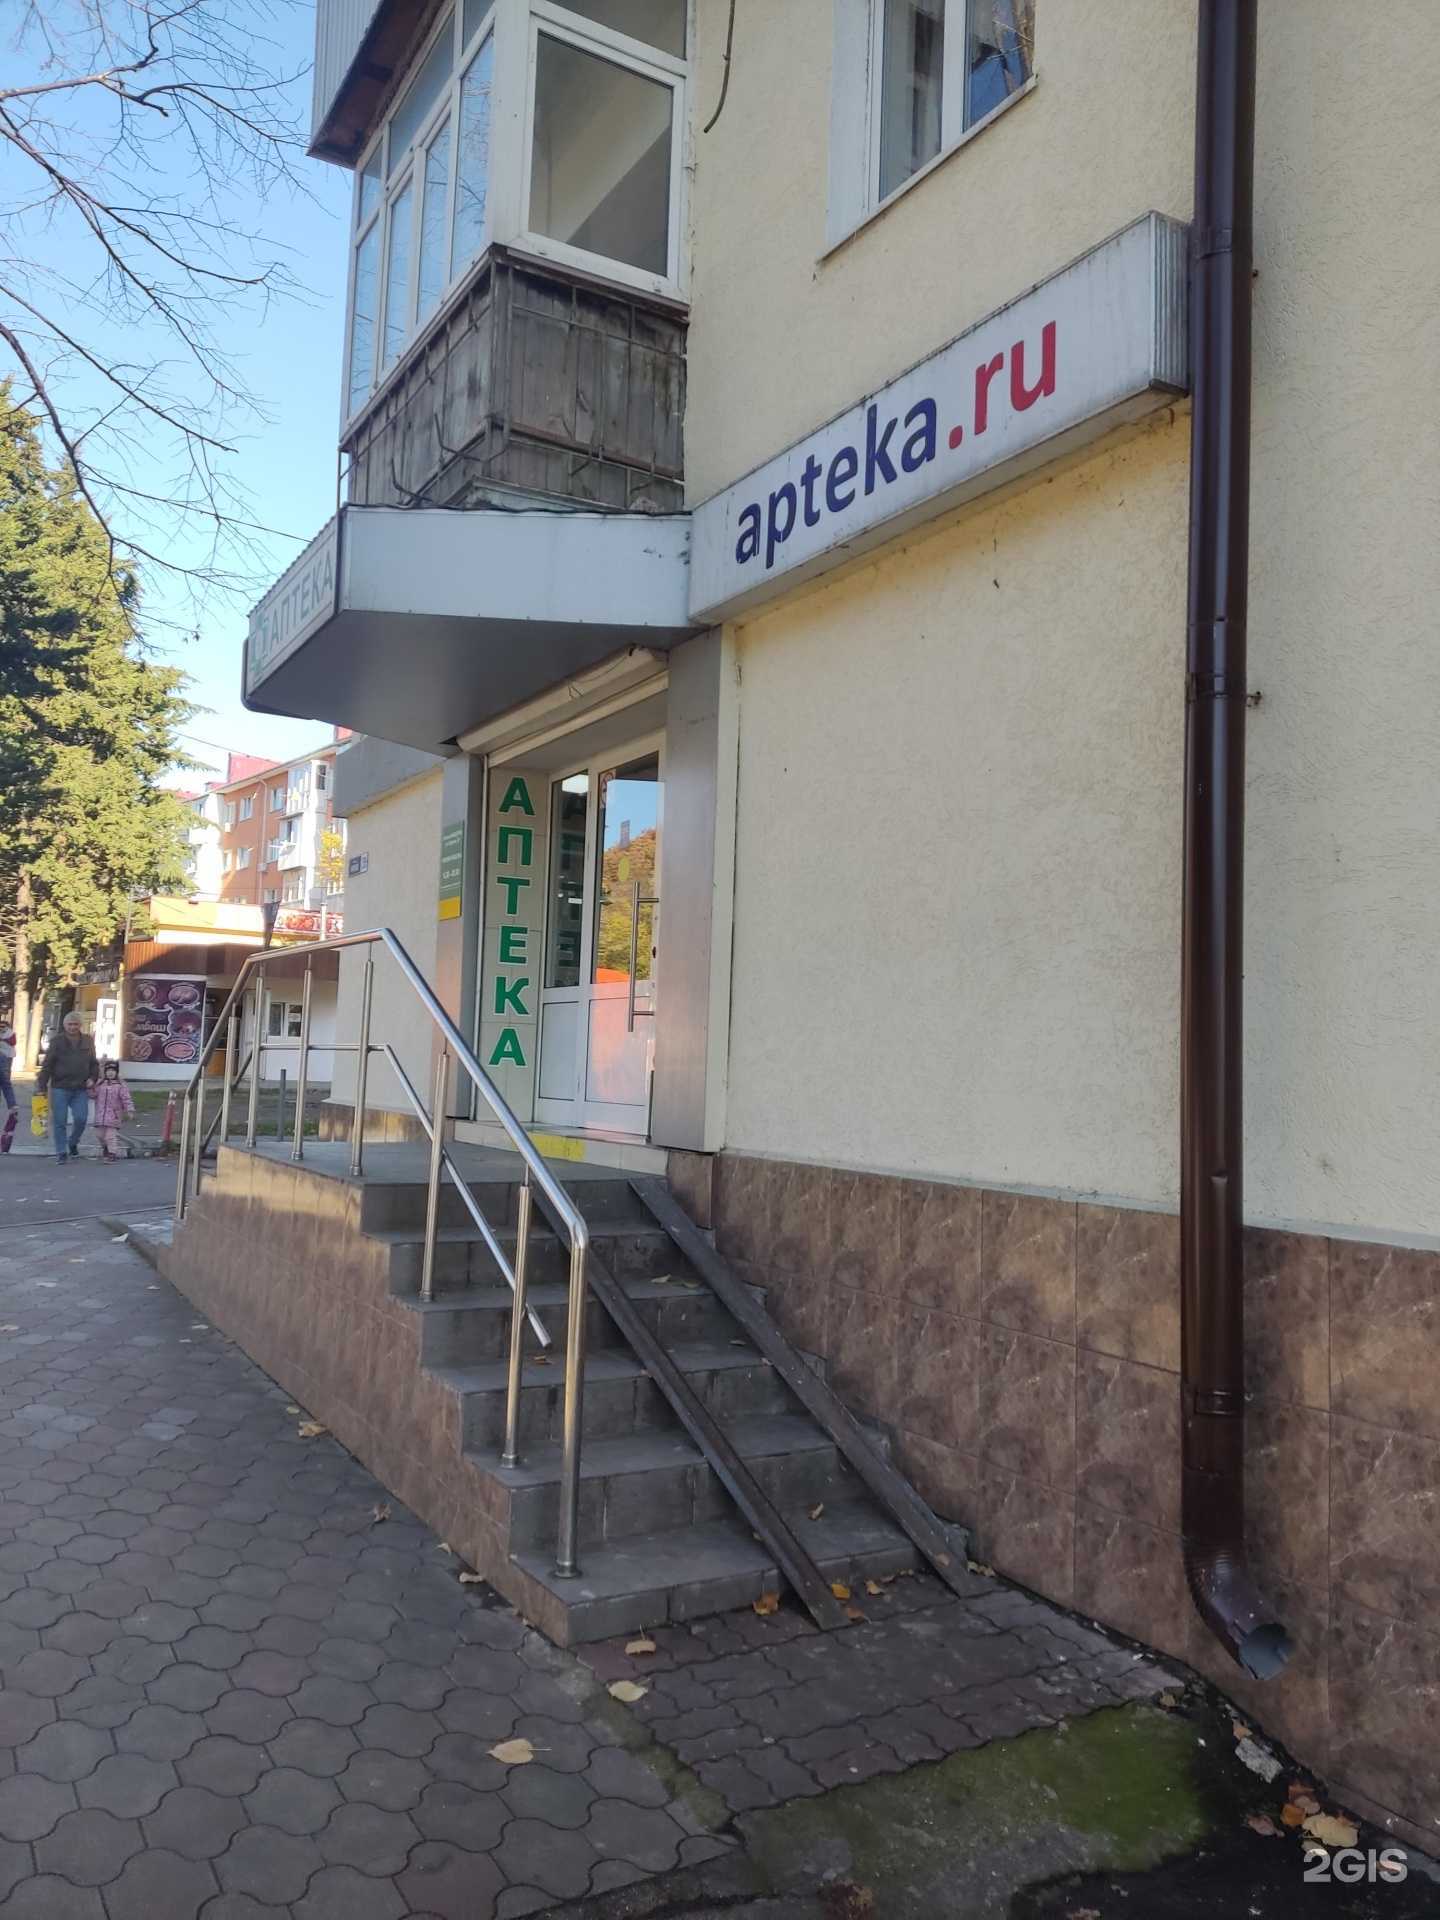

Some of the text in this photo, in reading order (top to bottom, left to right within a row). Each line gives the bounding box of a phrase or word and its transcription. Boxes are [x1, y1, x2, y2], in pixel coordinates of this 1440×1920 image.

[735, 320, 1057, 569] apteka.ru
[269, 549, 334, 656] АПТЕКА
[488, 776, 536, 1067] АПТЕКА
